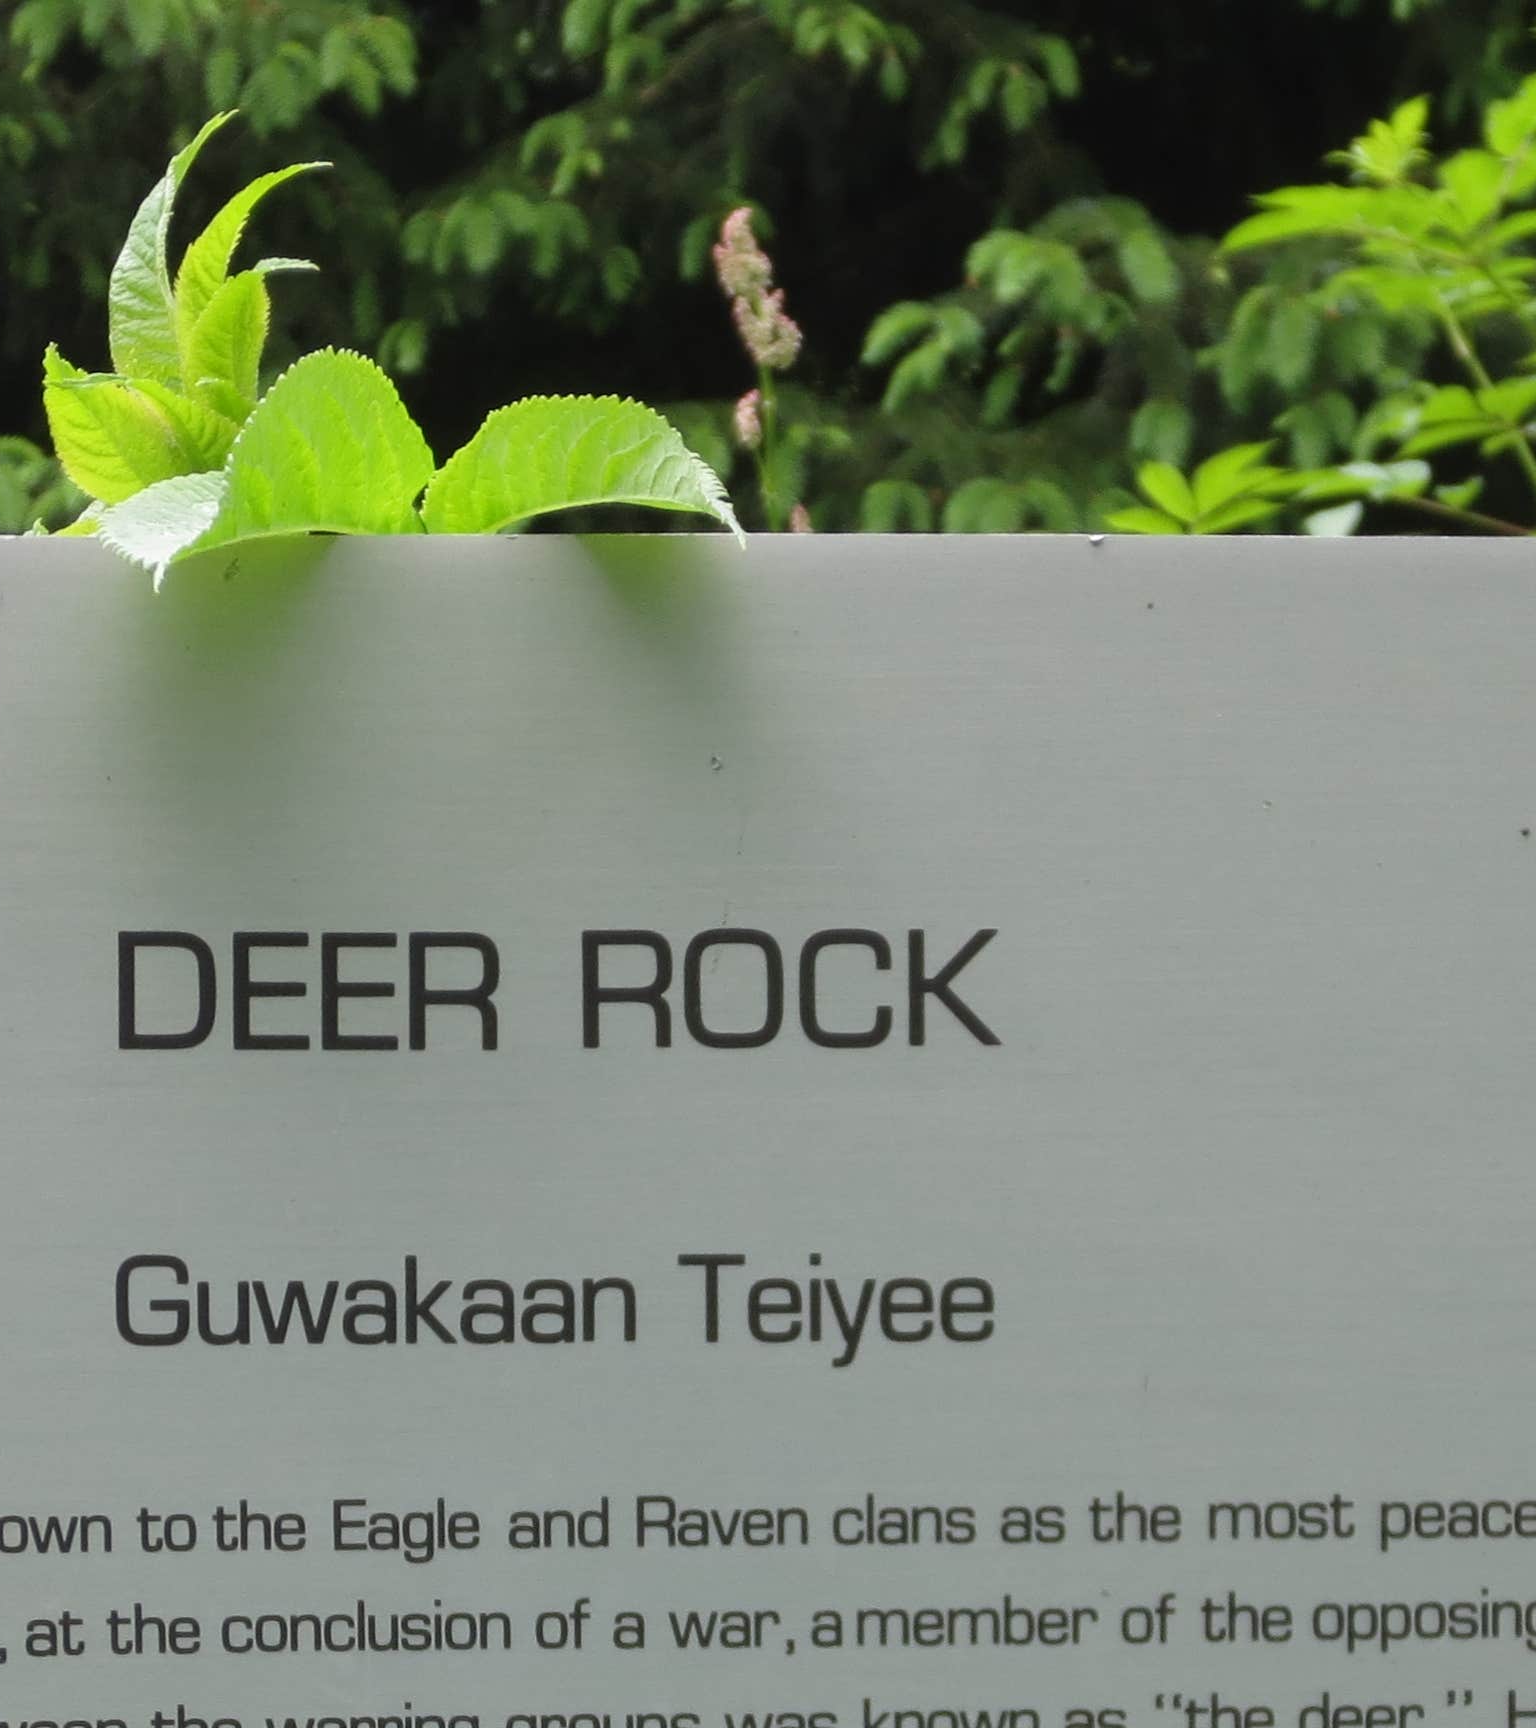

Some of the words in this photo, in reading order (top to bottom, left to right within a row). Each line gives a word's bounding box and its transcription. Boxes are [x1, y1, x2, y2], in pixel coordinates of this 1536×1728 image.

[117, 930, 501, 1052] DEER
[581, 927, 1003, 1050] ROCK
[115, 1253, 638, 1349] Guwakaan
[677, 1252, 997, 1370] Teiyee
[135, 1506, 198, 1554] to
[211, 1498, 307, 1553] the
[332, 1496, 481, 1565] Eagle
[508, 1495, 610, 1550] and
[636, 1494, 809, 1548] Raven
[832, 1492, 977, 1547] clans
[999, 1505, 1066, 1545] as
[1087, 1490, 1182, 1544] the
[1208, 1493, 1356, 1541] most
[25, 1610, 86, 1658] at
[105, 1602, 201, 1656] the
[221, 1598, 512, 1655] conclusion
[534, 1597, 591, 1650] of
[612, 1611, 646, 1651] a
[668, 1610, 796, 1656] war,
[810, 1609, 844, 1649] a
[856, 1594, 1099, 1648] member
[1120, 1592, 1176, 1645] of
[1200, 1590, 1293, 1644] the
